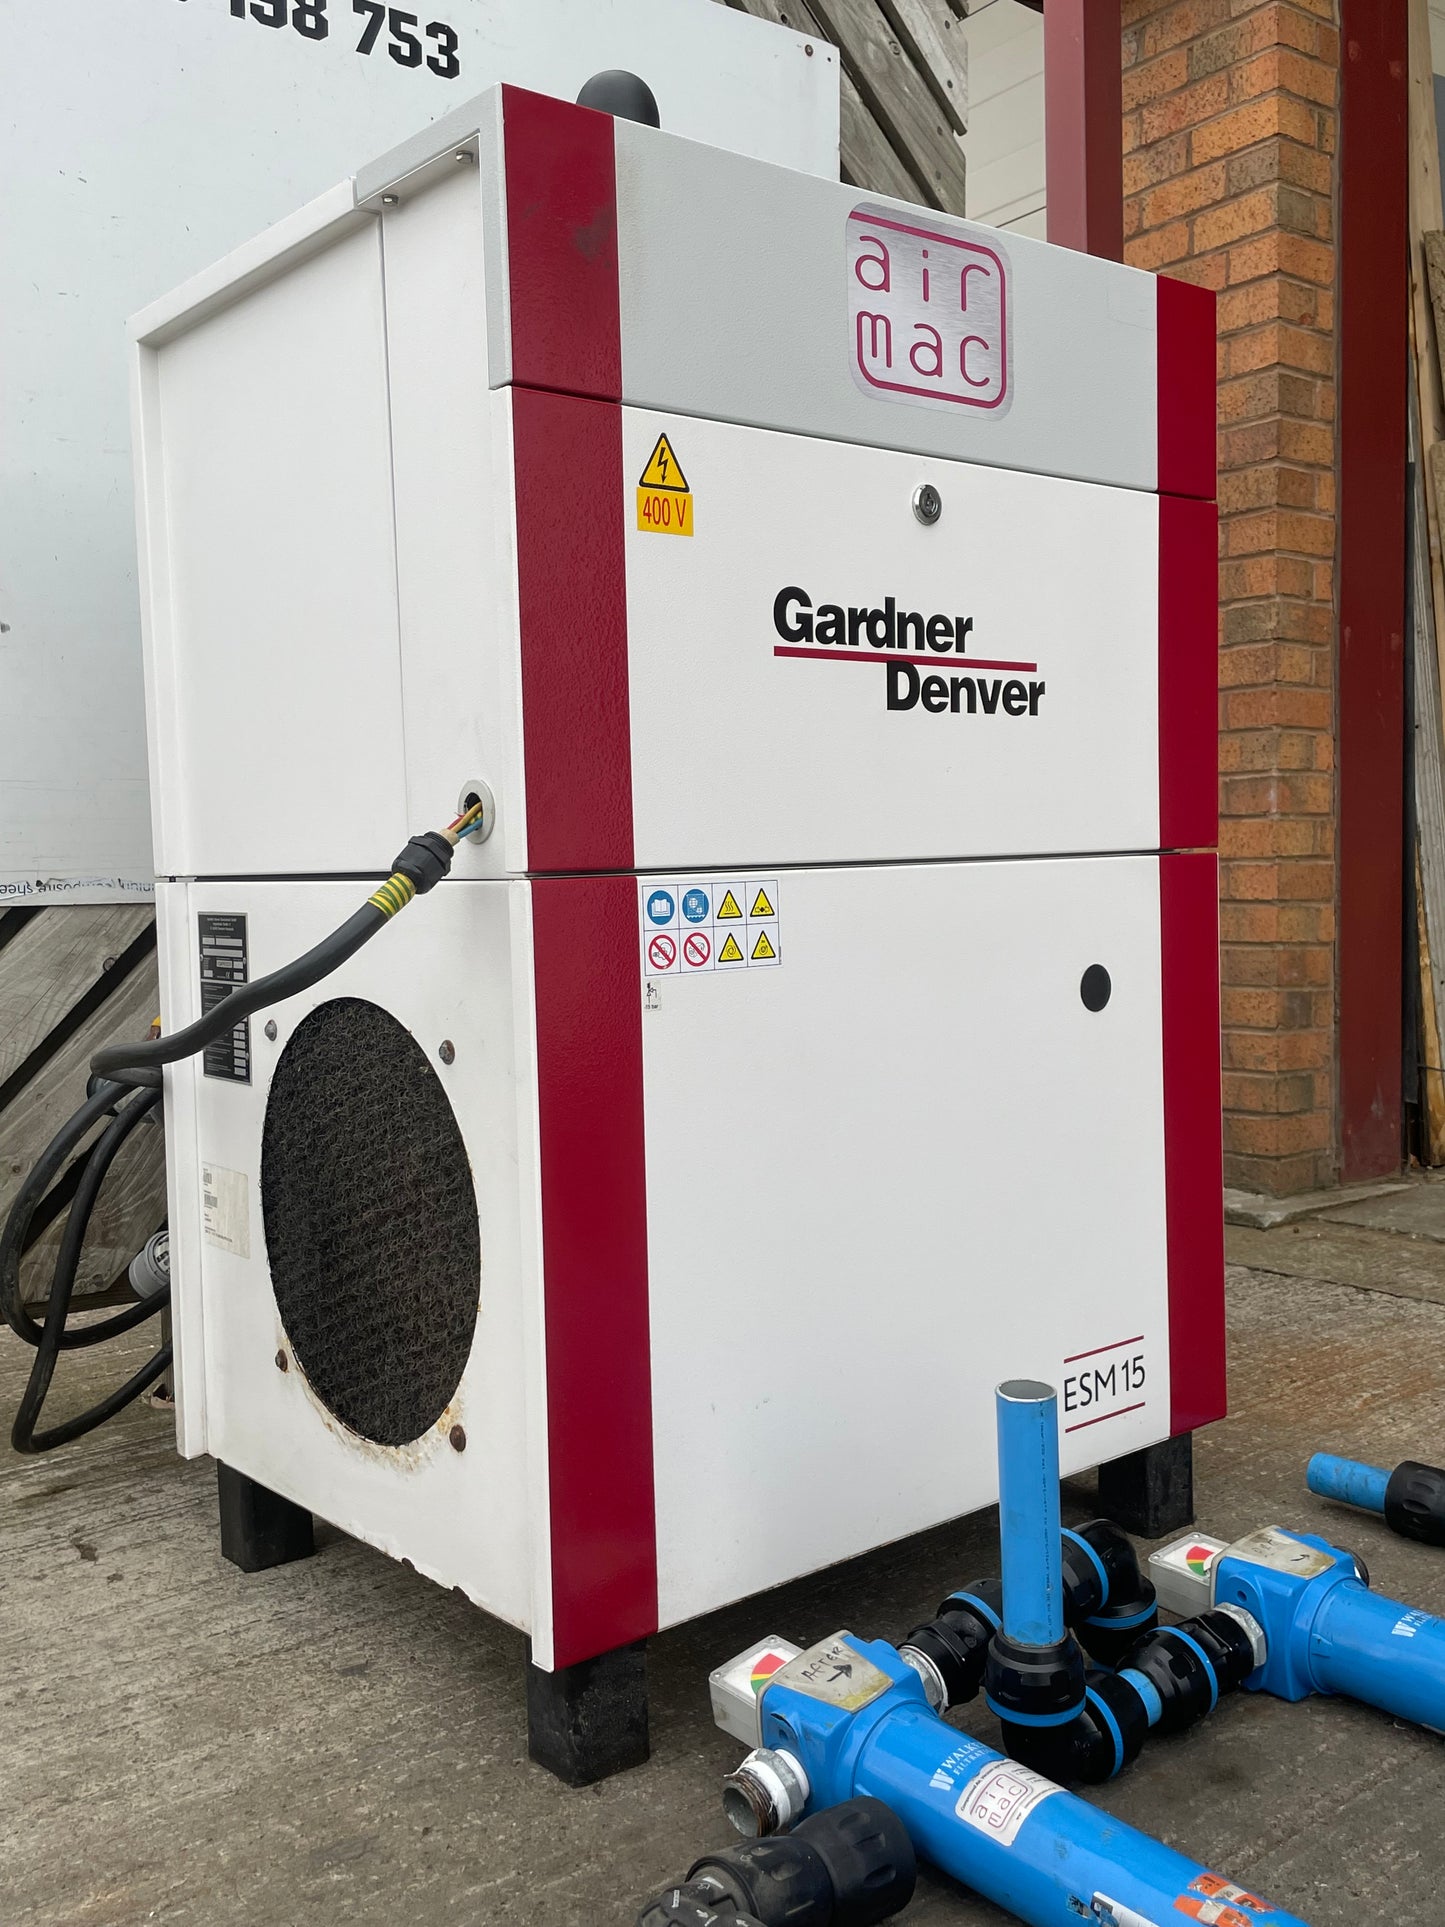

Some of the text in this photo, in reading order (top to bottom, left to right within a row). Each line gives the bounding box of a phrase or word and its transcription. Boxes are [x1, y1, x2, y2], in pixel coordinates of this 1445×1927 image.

[352, 0, 460, 79] 753
[855, 235, 990, 311] air
[857, 311, 990, 387] mac
[643, 496, 687, 528] 400 V
[773, 586, 973, 653] Gardner
[886, 660, 1045, 716] Denver
[1064, 1355, 1146, 1412] ESM 15
[975, 1777, 1004, 1819] air
[987, 1785, 1022, 1828] mac
